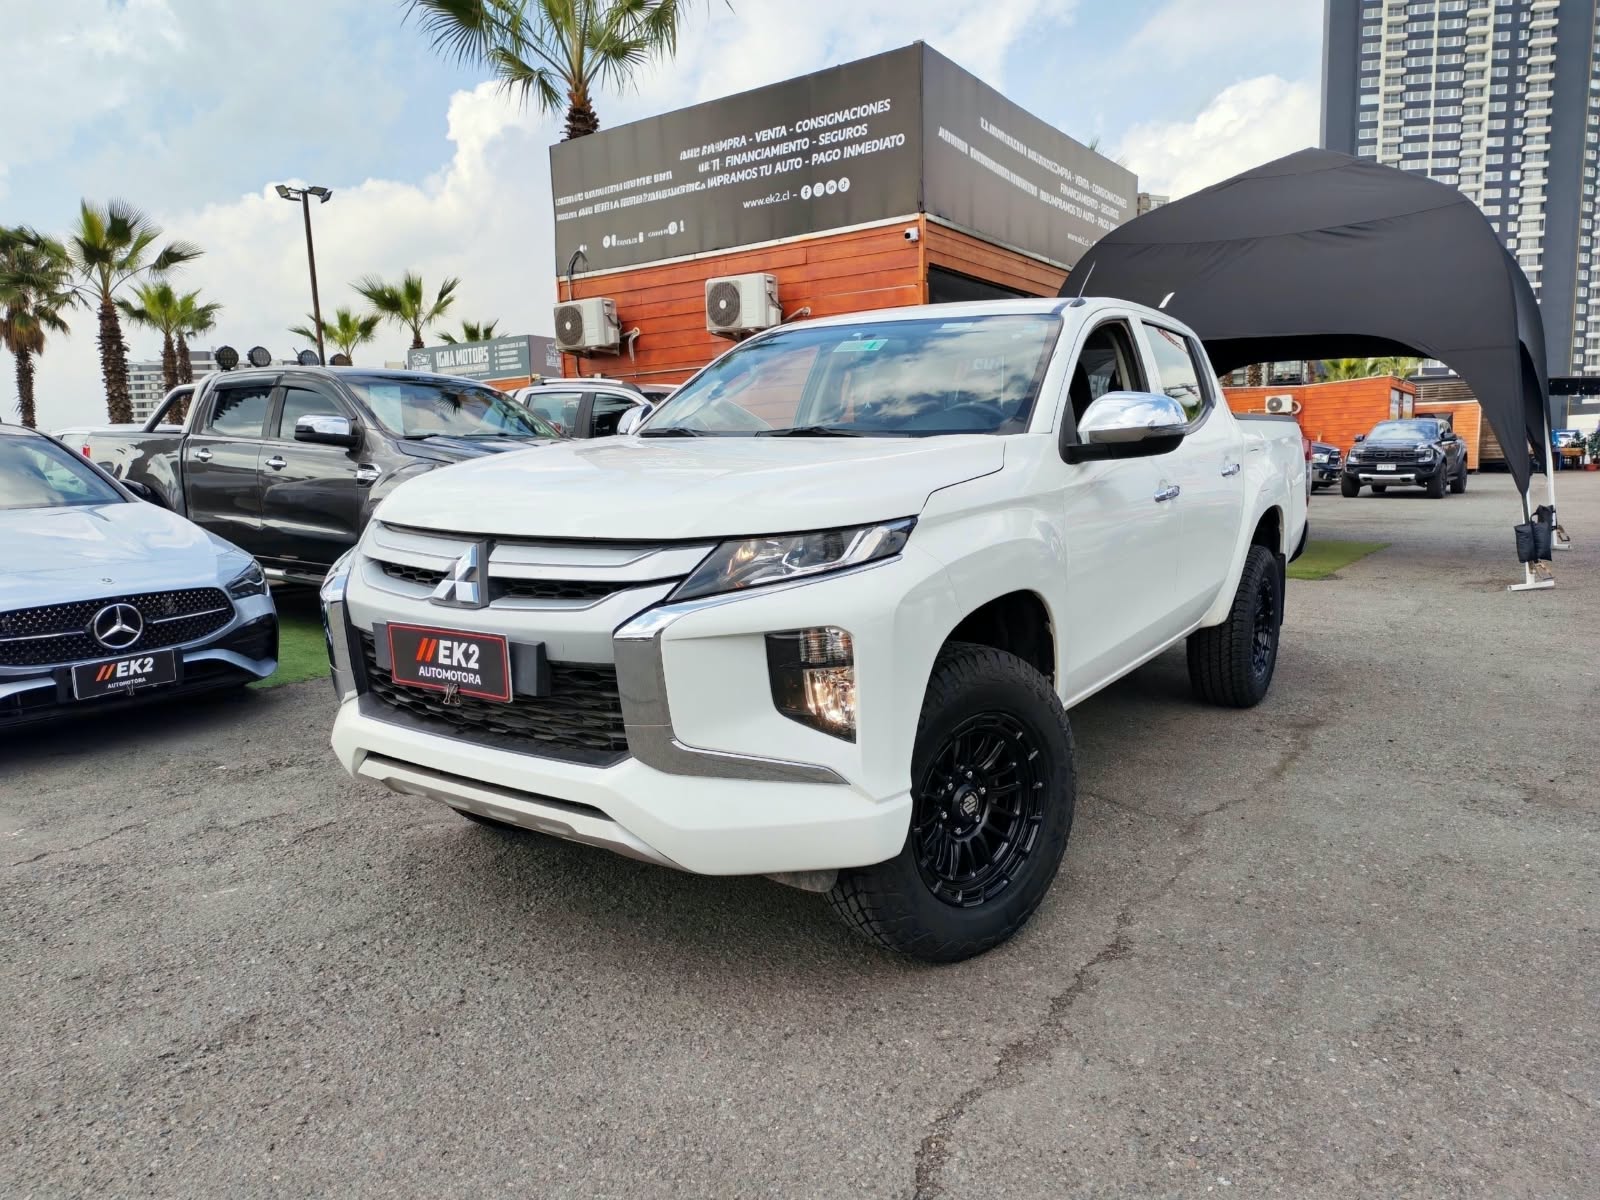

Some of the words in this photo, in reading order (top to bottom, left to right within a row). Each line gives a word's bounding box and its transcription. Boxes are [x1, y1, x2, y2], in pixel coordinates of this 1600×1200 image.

[755, 125, 787, 143] VENTA
[795, 98, 891, 133] CONSIGNACIONES
[725, 137, 810, 168] FINANCIAMIENTO
[818, 123, 868, 146] SEGUROS
[759, 164, 773, 177] TU
[774, 157, 803, 174] AUTO
[811, 148, 841, 166] PAGO
[843, 133, 905, 159] INMEDIATO
[742, 190, 790, 209] www.ek2.cl
[455, 346, 489, 365] MOTORS
[438, 640, 479, 669] EK2
[116, 657, 154, 678] EK2
[418, 666, 481, 685] AUTOMOTORA
[107, 677, 146, 689] AUTOMOTORA
